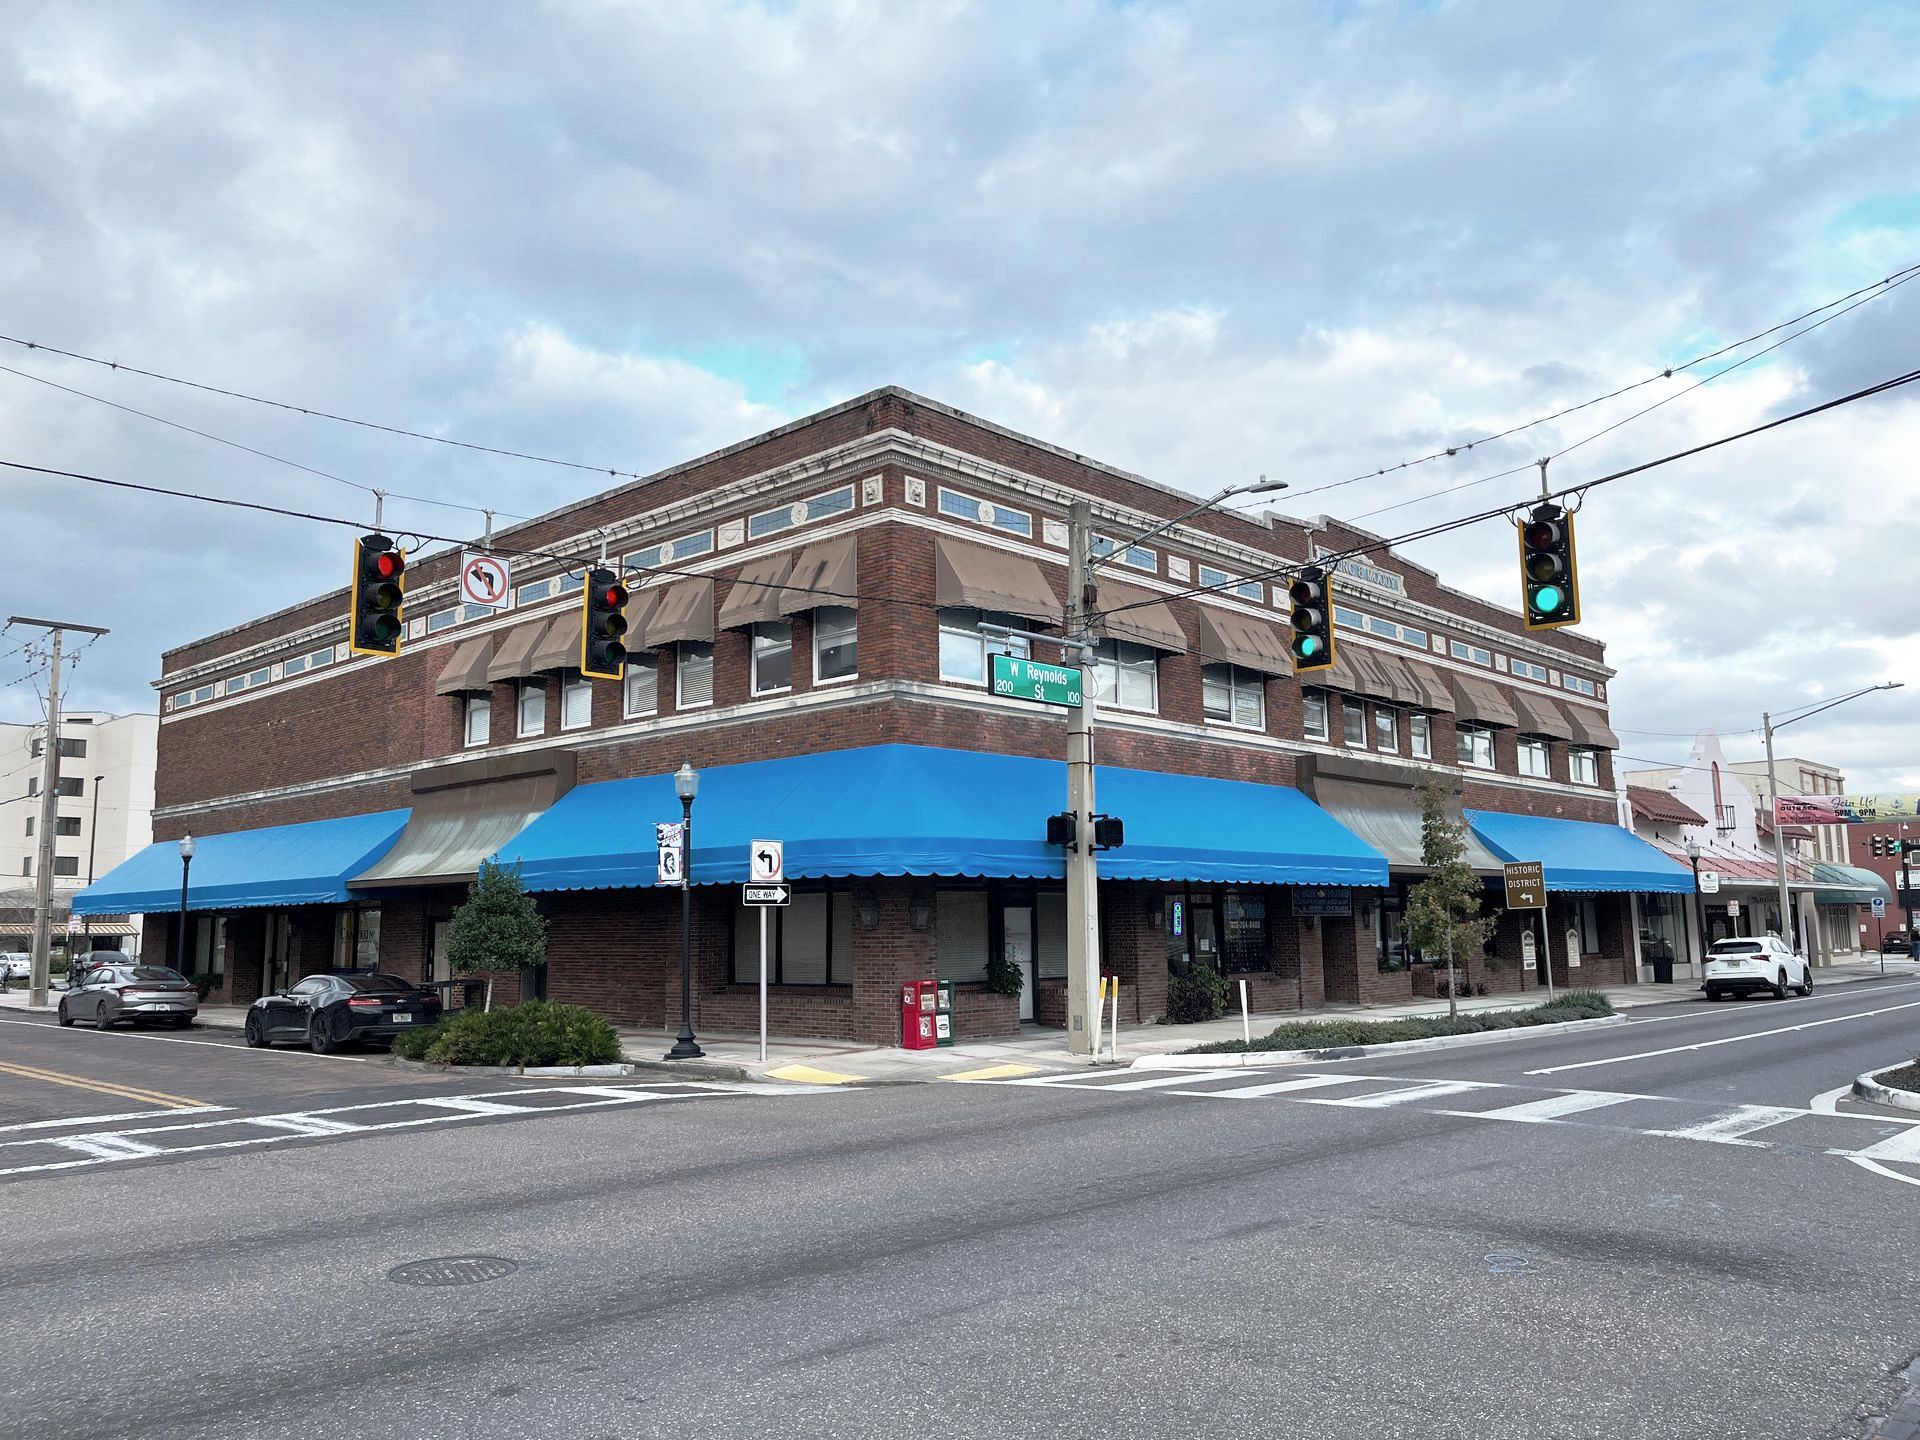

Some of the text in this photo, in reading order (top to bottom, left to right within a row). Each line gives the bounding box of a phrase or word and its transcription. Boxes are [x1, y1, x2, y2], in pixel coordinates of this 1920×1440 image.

[1367, 568, 1395, 588] MOODY
[1010, 661, 1067, 685] W Reynolds
[996, 679, 1013, 693] 200
[1034, 684, 1045, 700] St
[1067, 691, 1080, 703] 100
[1831, 796, 1877, 809] Join Us!
[1834, 809, 1851, 817] 5PM
[1859, 809, 1876, 817] 9PM
[1506, 865, 1540, 875] HISTORIC
[1508, 878, 1540, 888] DISTRICT
[748, 891, 776, 899] ONE WAY
[1174, 904, 1182, 933] OPEN
